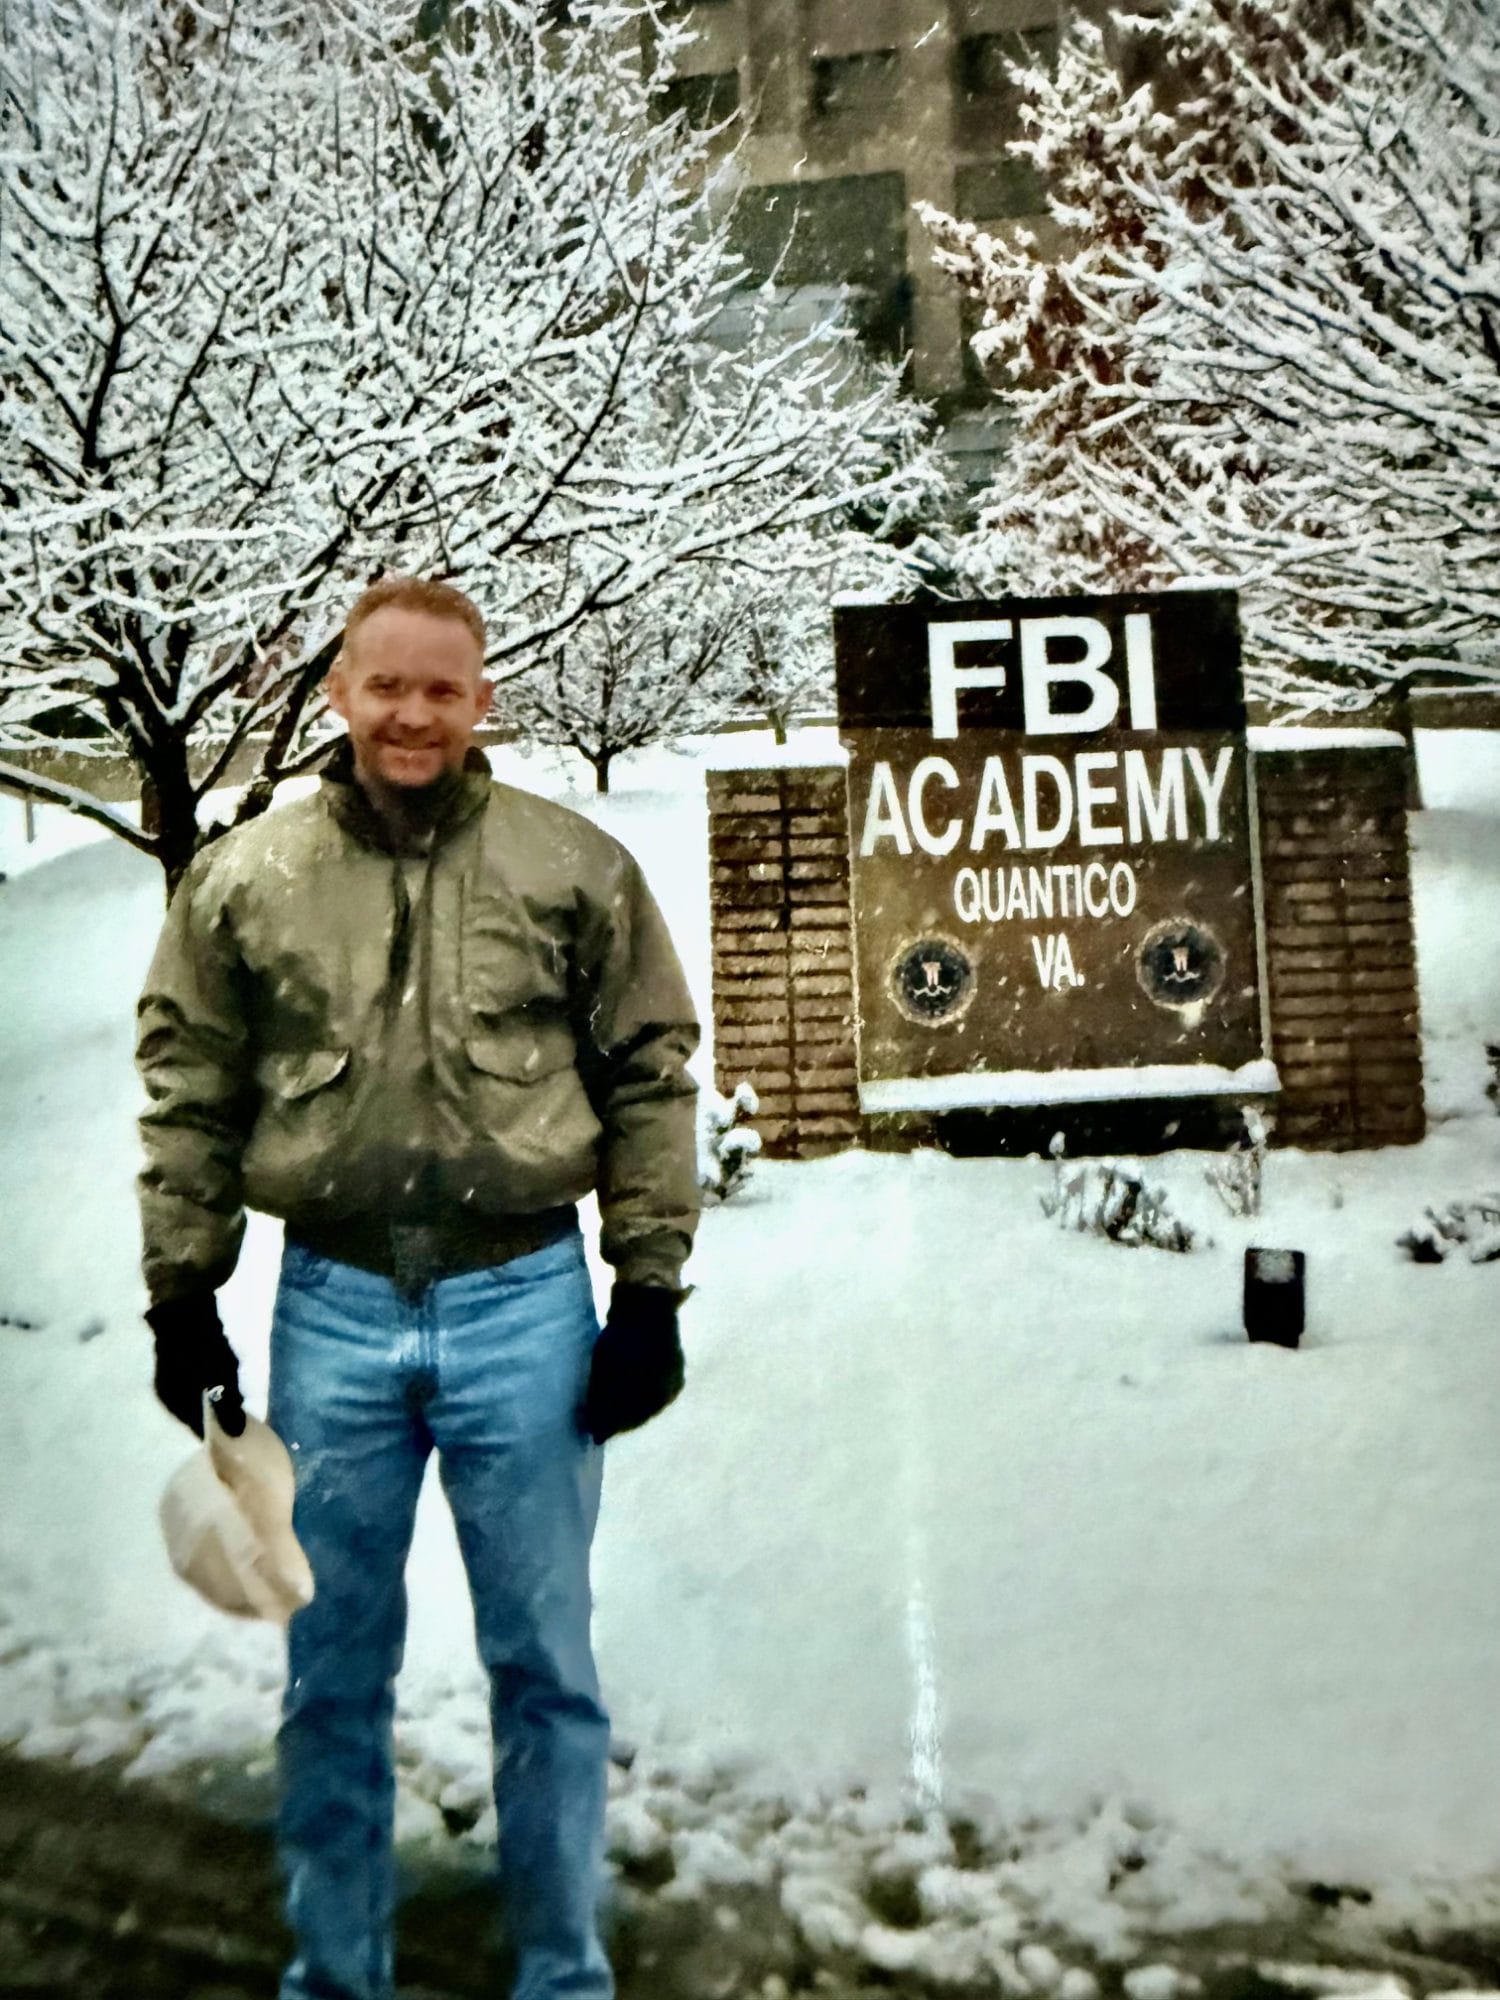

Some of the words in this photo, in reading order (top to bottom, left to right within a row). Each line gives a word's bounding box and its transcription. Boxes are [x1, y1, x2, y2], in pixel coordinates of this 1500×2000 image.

[927, 613, 1158, 740] FBI
[859, 746, 1234, 857] ACADEMY
[953, 862, 1137, 923] QUANTICO
[1032, 933, 1085, 988] VA.
